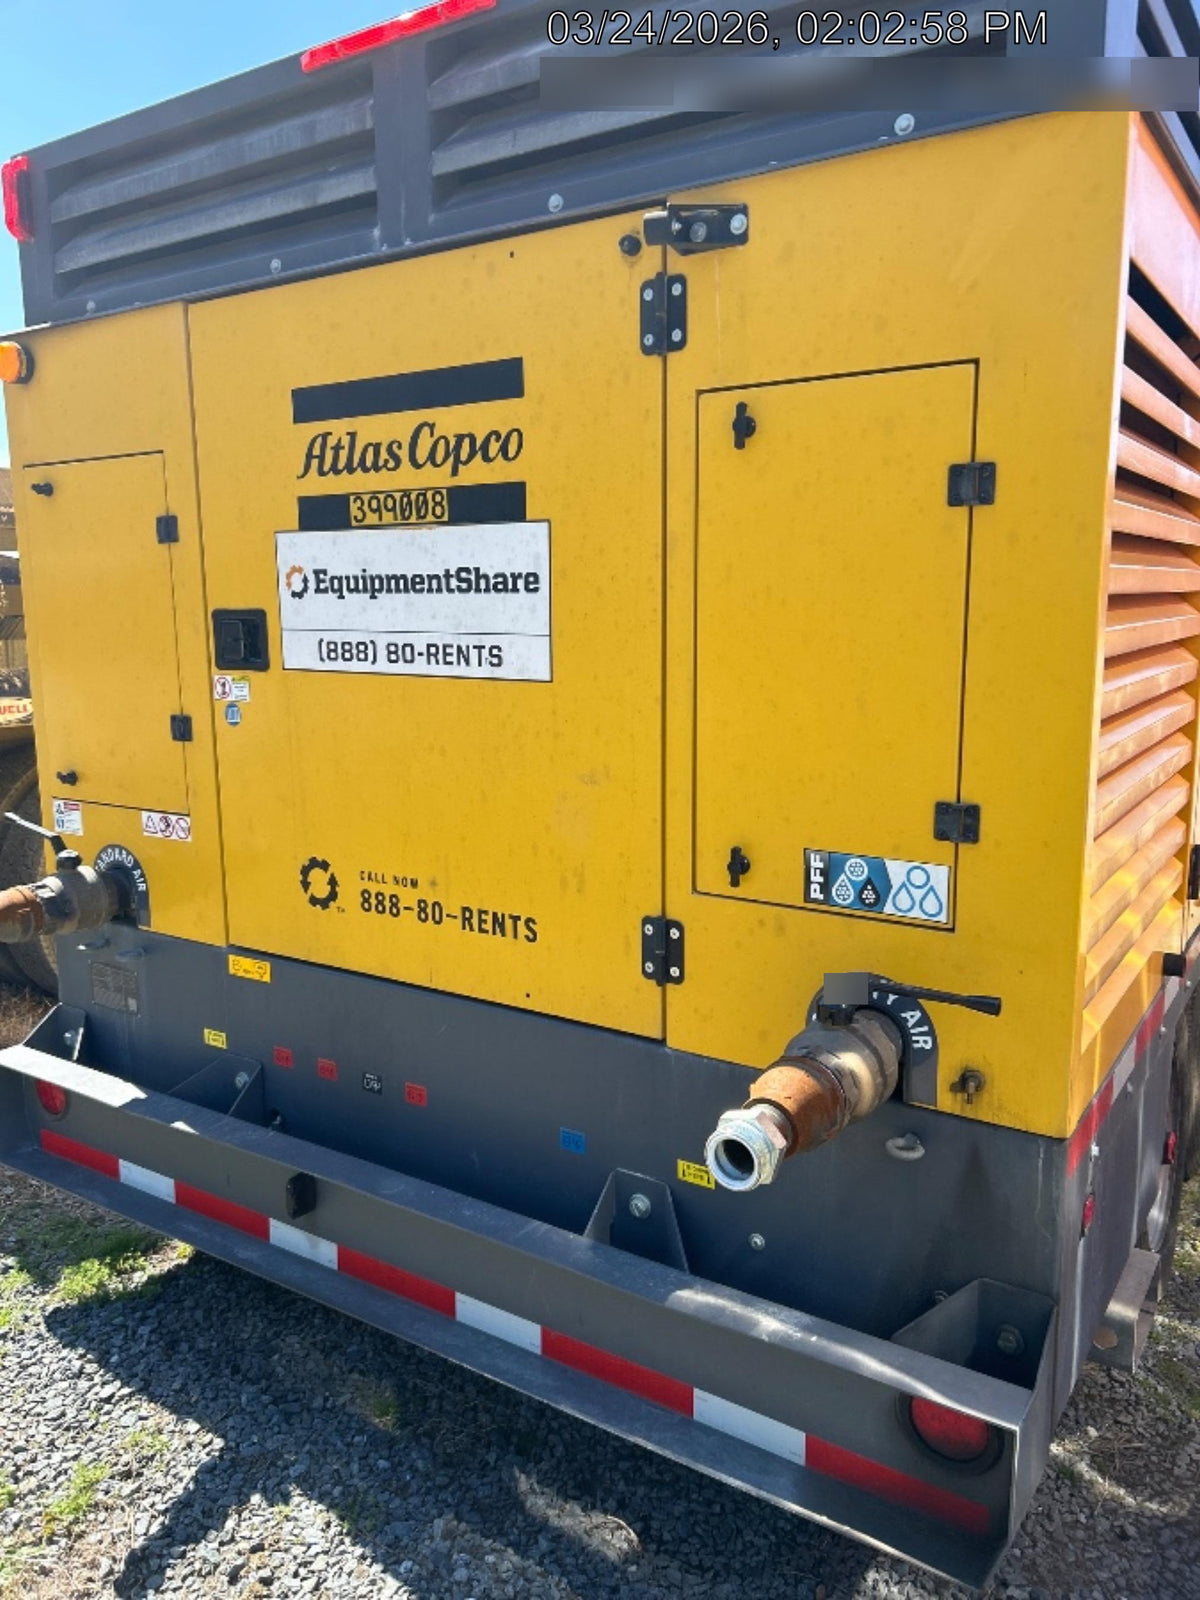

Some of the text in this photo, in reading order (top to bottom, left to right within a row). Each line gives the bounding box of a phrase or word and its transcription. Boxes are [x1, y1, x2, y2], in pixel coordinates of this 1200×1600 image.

[297, 421, 523, 479] Atlas Copco
[353, 489, 446, 523] 399008
[314, 566, 540, 599] EquipmentShare
[318, 638, 503, 668] (888) 80-RENTS
[133, 868, 147, 891] AIR
[360, 870, 419, 889] CALL NOW
[810, 853, 824, 900] PFF
[360, 889, 538, 943] 888-80-RENTS
[901, 1009, 932, 1050] AIR
